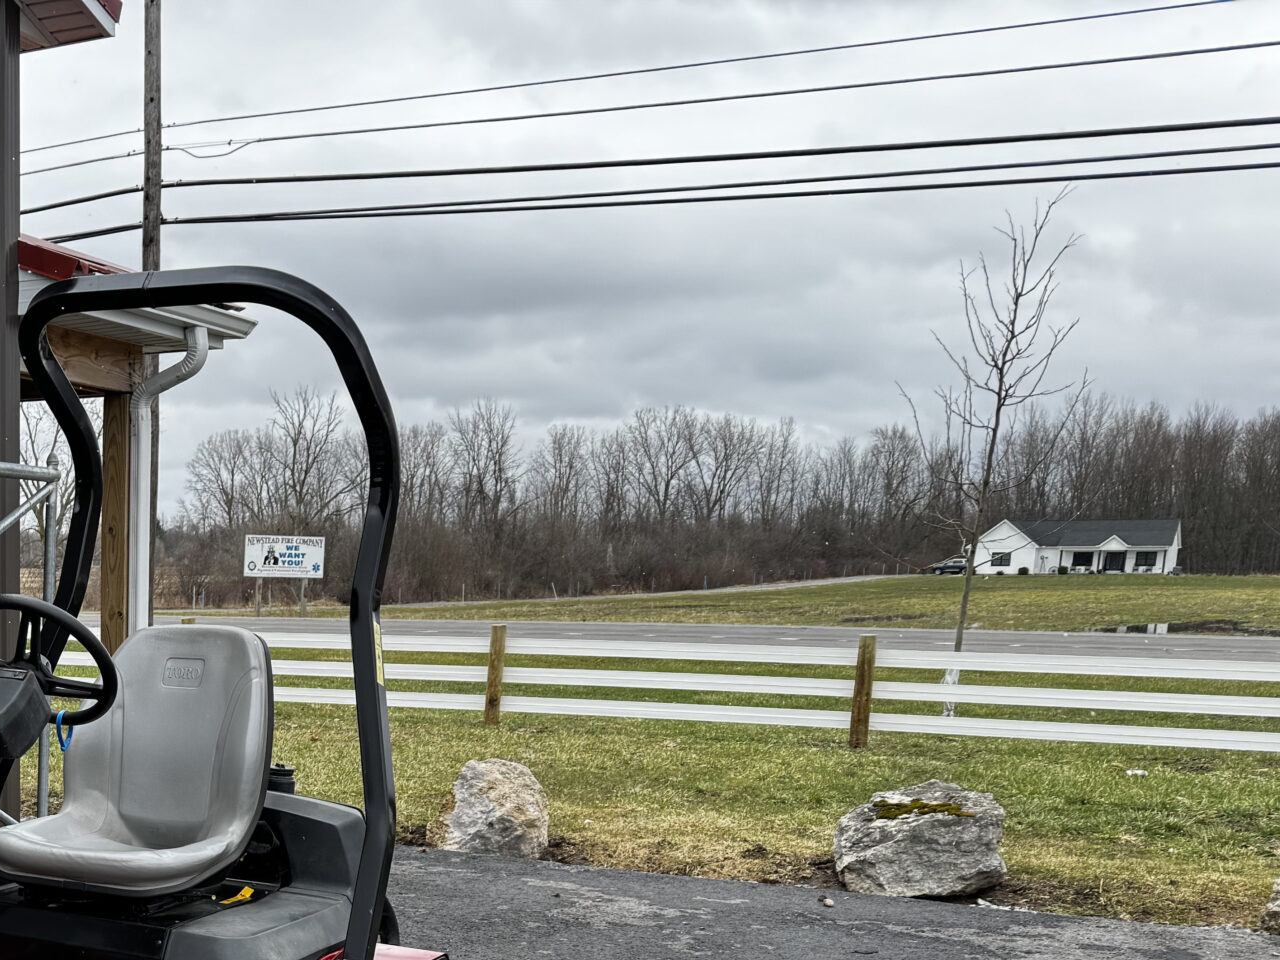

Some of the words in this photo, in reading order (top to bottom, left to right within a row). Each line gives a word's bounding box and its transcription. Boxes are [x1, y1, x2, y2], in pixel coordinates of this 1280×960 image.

[247, 536, 280, 546] NEWSTEAD
[295, 538, 323, 548] COMPANY
[167, 666, 201, 680] TORO
